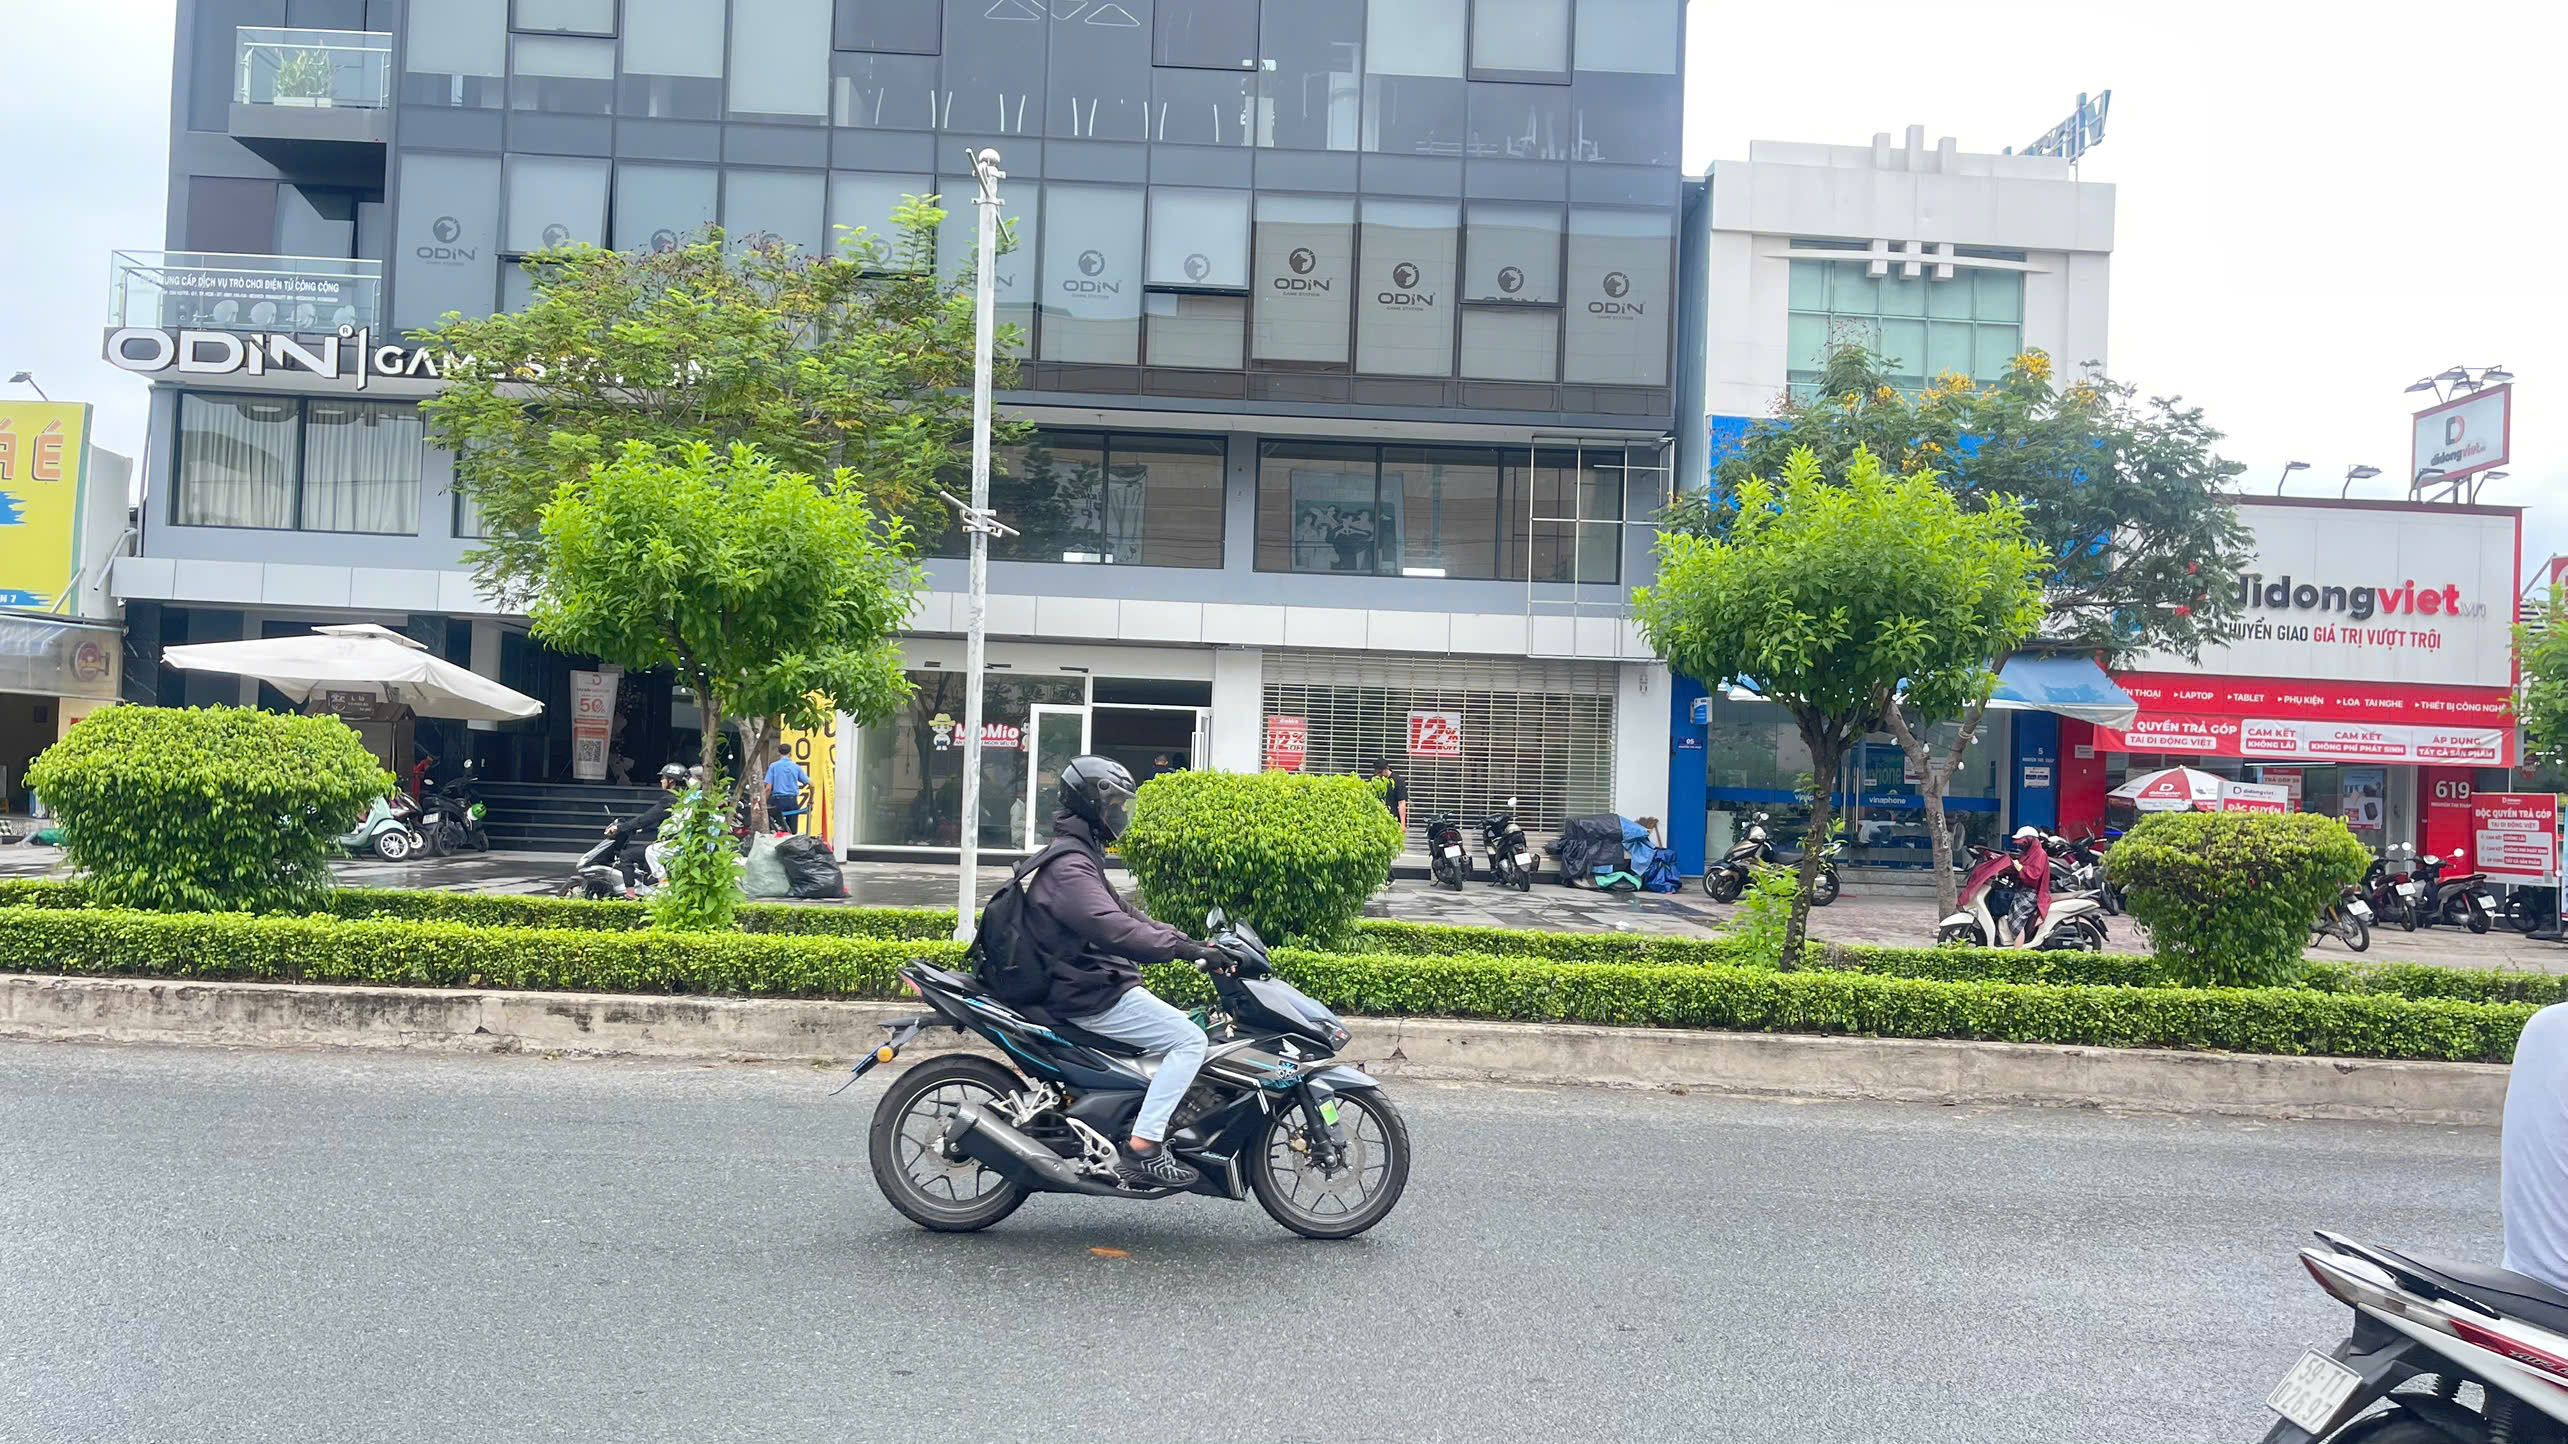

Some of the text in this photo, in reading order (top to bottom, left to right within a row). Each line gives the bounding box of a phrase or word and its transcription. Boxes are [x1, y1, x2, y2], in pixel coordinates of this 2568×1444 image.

[160, 276, 180, 287] UNG
[10, 593, 17, 604] 7
[2277, 625, 2308, 642] GIAO
[2313, 622, 2336, 643] GIÁ
[2340, 627, 2363, 648] TRỊ
[2367, 627, 2406, 651] VƯỢT
[2410, 628, 2441, 652] TRỘI
[2135, 688, 2161, 699] THOẠI
[2180, 691, 2214, 700] LAPTOP
[2233, 693, 2265, 702] TABLET
[2284, 695, 2302, 706] PHỤ
[2303, 696, 2325, 706] KIỆN
[2342, 697, 2361, 707] LOA
[2365, 699, 2378, 708] TAI
[2378, 700, 2404, 709] NGHE
[2421, 699, 2446, 710] THIẾT
[2446, 702, 2455, 713] BỊ
[2456, 701, 2482, 711] CÔNG
[2182, 719, 2208, 734] TRẢ
[2210, 721, 2238, 736] GÓP
[2247, 727, 2297, 739] CAM KẾT
[2334, 730, 2383, 742] CAM KẾT
[2432, 735, 2450, 745] ÁP
[2247, 739, 2279, 750] KHÔNG
[2311, 742, 2341, 752] KHÔNG
[2343, 743, 2359, 752] PHÍ
[2360, 743, 2382, 754] PHÁT
[2038, 747, 2044, 755] 5
[2435, 780, 2470, 800] 619
[1868, 795, 1906, 805] vinaphone
